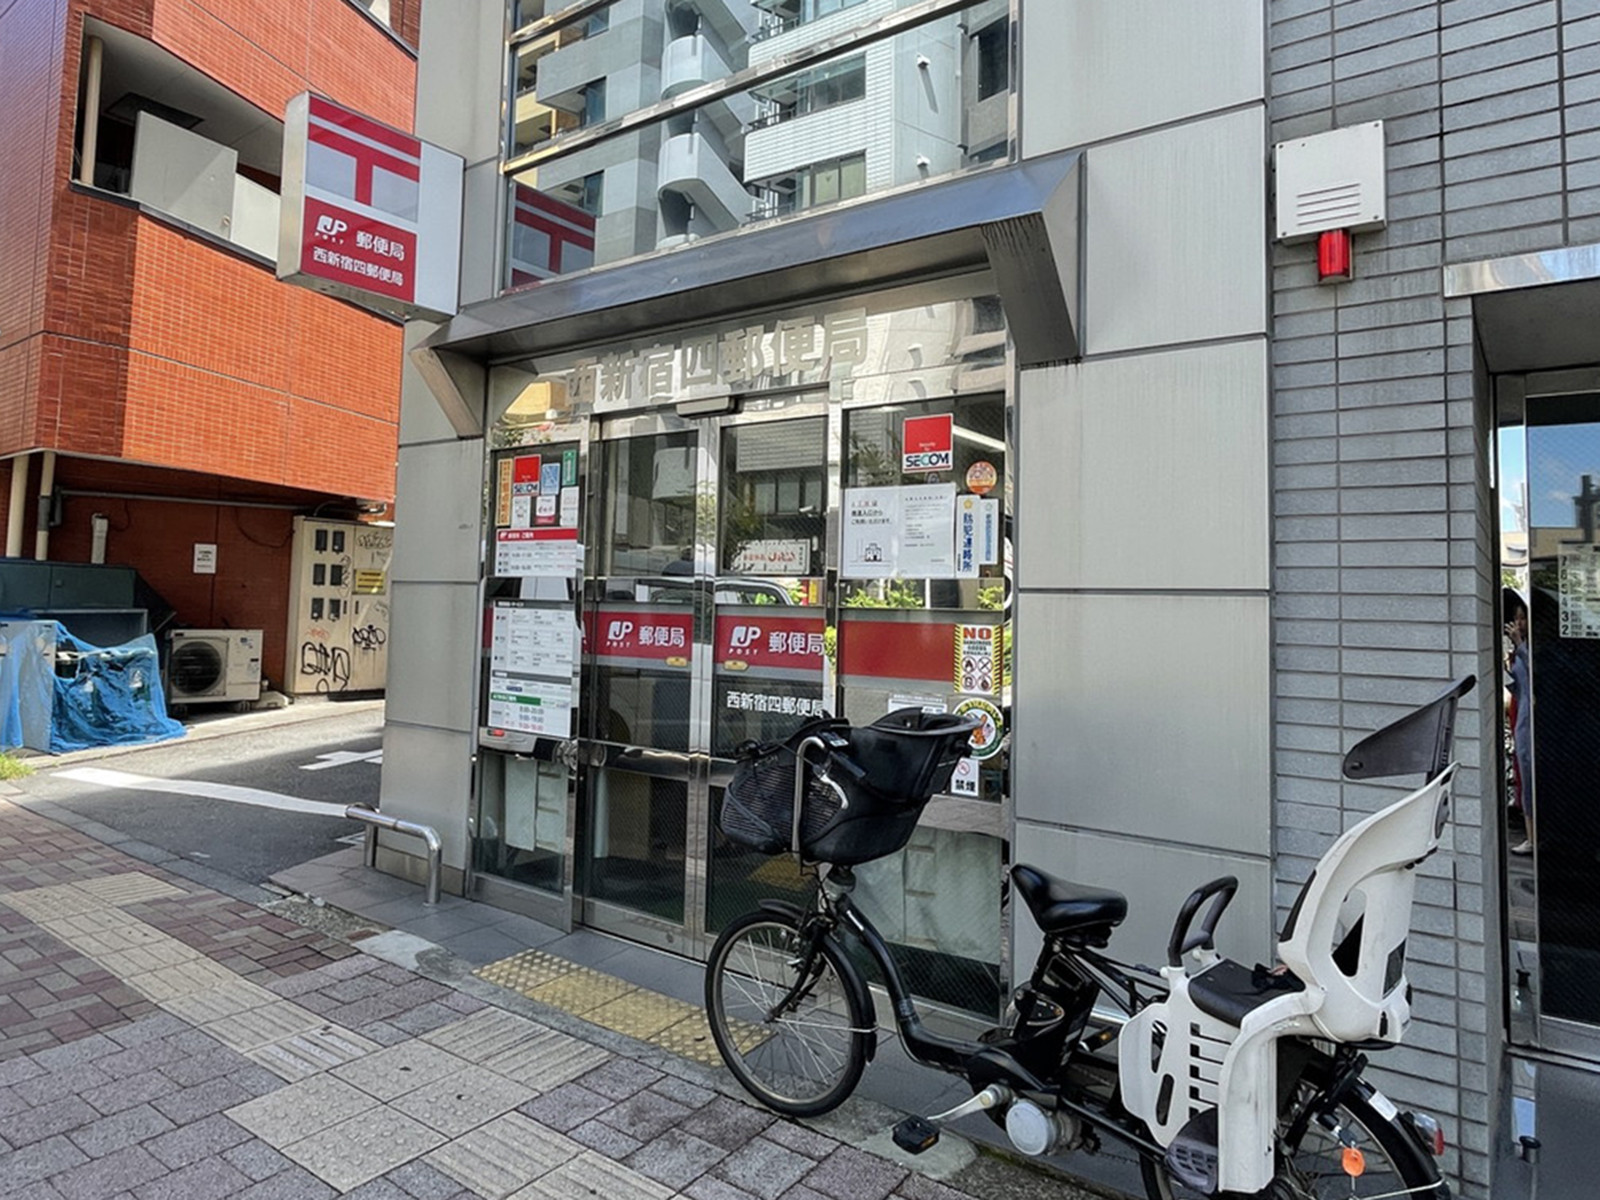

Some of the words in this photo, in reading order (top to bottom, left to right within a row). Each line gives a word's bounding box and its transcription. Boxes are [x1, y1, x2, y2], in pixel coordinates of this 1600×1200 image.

[356, 231, 405, 261] 郵便局
[314, 246, 403, 286] 西新宿四郵便局
[565, 307, 868, 403] 西新宿四郵便局
[905, 453, 949, 468] SECOM
[1561, 611, 1569, 622] 3
[639, 625, 686, 648] 郵便局
[963, 627, 992, 640] NO
[1561, 625, 1569, 635] 2
[606, 641, 632, 650] POST
[768, 631, 824, 656] 郵便局
[729, 647, 760, 656] POST
[726, 691, 824, 718] 西新宿四郵便局
[955, 778, 976, 793] 禁煙
